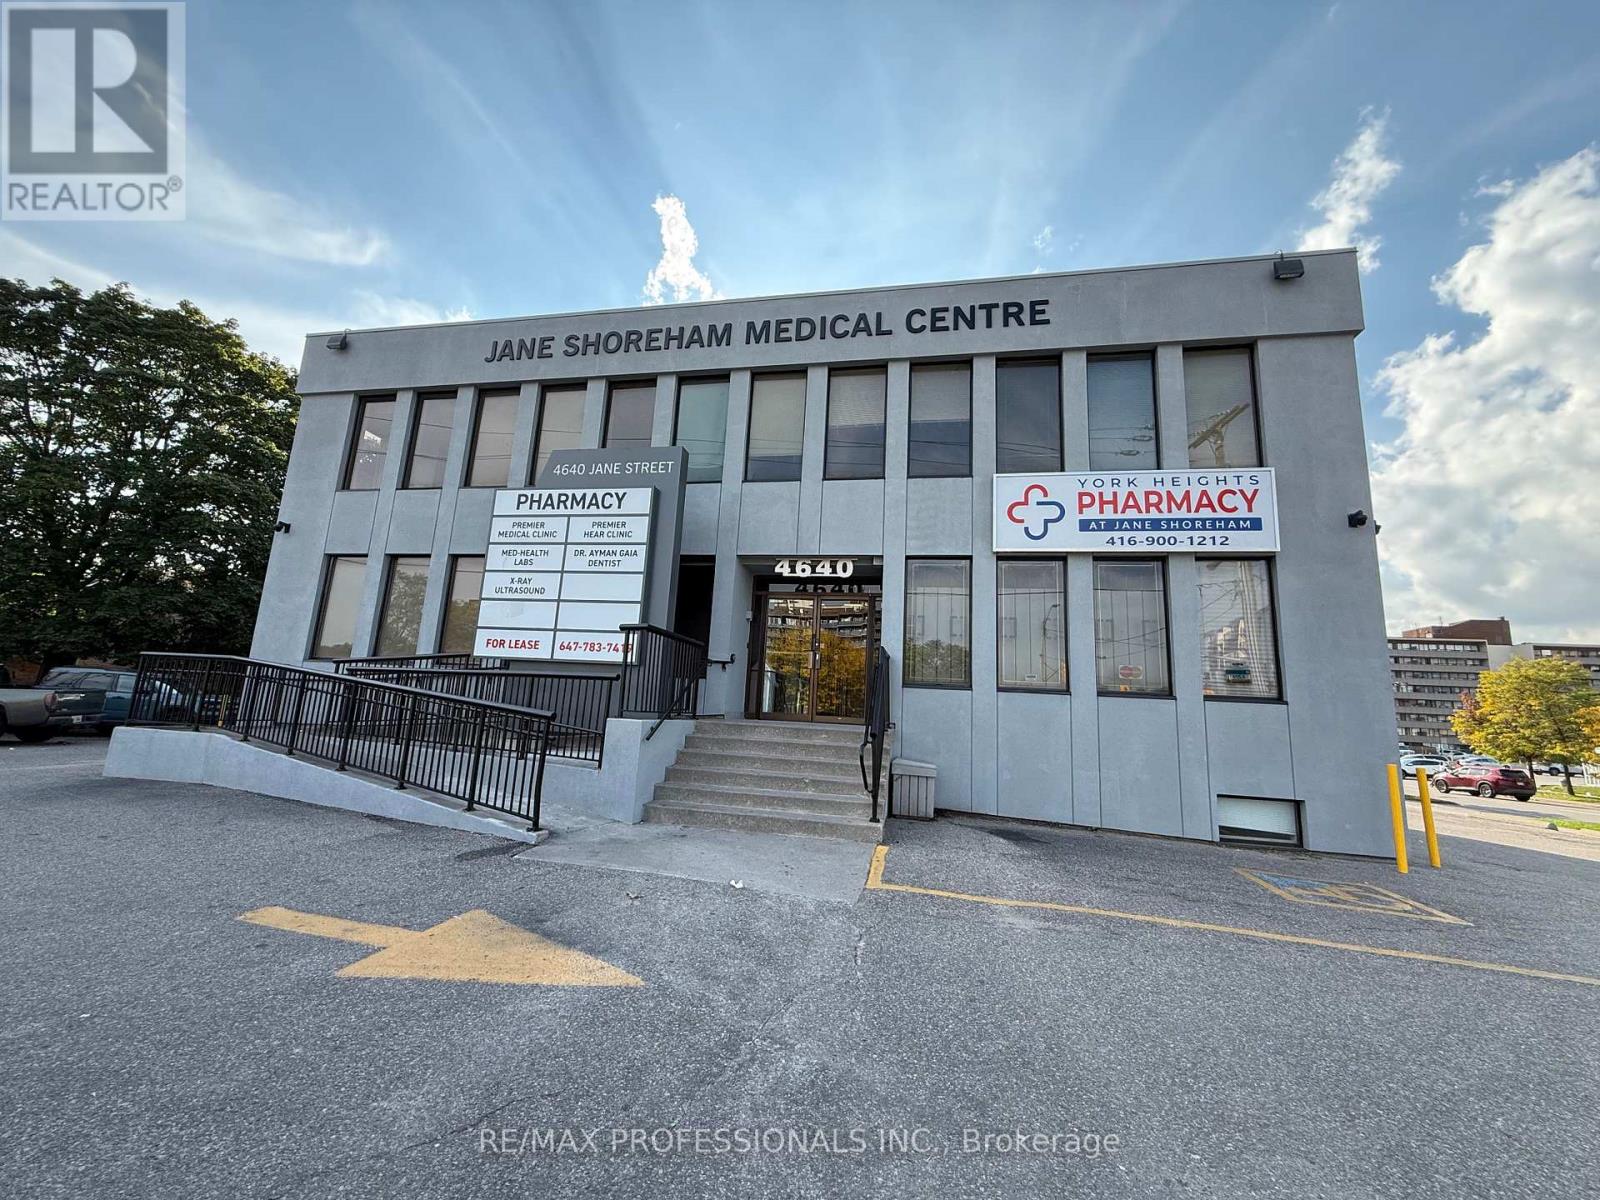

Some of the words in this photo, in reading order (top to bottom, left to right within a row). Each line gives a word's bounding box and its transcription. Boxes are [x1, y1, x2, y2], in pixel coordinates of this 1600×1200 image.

[484, 335, 554, 363] JANE
[562, 322, 733, 357] SHOREHAM
[743, 311, 893, 345] MEDICAL
[905, 299, 1051, 333] CENTRE
[553, 464, 586, 476] 4640
[589, 463, 621, 475] JANE
[625, 461, 675, 474] STREET
[1077, 477, 1139, 488] YORK
[1153, 474, 1260, 487] HEIGHTS
[515, 491, 627, 510] PHARMACY
[1077, 488, 1260, 515] PHARMACY
[512, 521, 545, 529] PREMIER
[592, 521, 627, 529] PREMIER
[1089, 521, 1106, 530] AT
[1114, 520, 1152, 530] JANE
[1161, 519, 1252, 529] SHOREHAM
[497, 530, 531, 538] MEDICAL
[532, 530, 558, 538] CLINIC
[583, 530, 605, 538] HEAR
[606, 530, 633, 538] CLINIC
[1105, 535, 1230, 546] 416-900-1212
[501, 549, 549, 557] MED-HEALTH
[573, 549, 587, 557] DR.
[589, 549, 617, 557] AYMAN
[619, 549, 638, 557] GAIA
[514, 558, 534, 566] LABS
[588, 559, 621, 567] DENTIST
[774, 558, 854, 578] 4640
[509, 577, 533, 585] X-RAY
[494, 586, 546, 595] ULTRASOUND
[485, 638, 506, 649] FOR
[508, 639, 540, 650] LEASE
